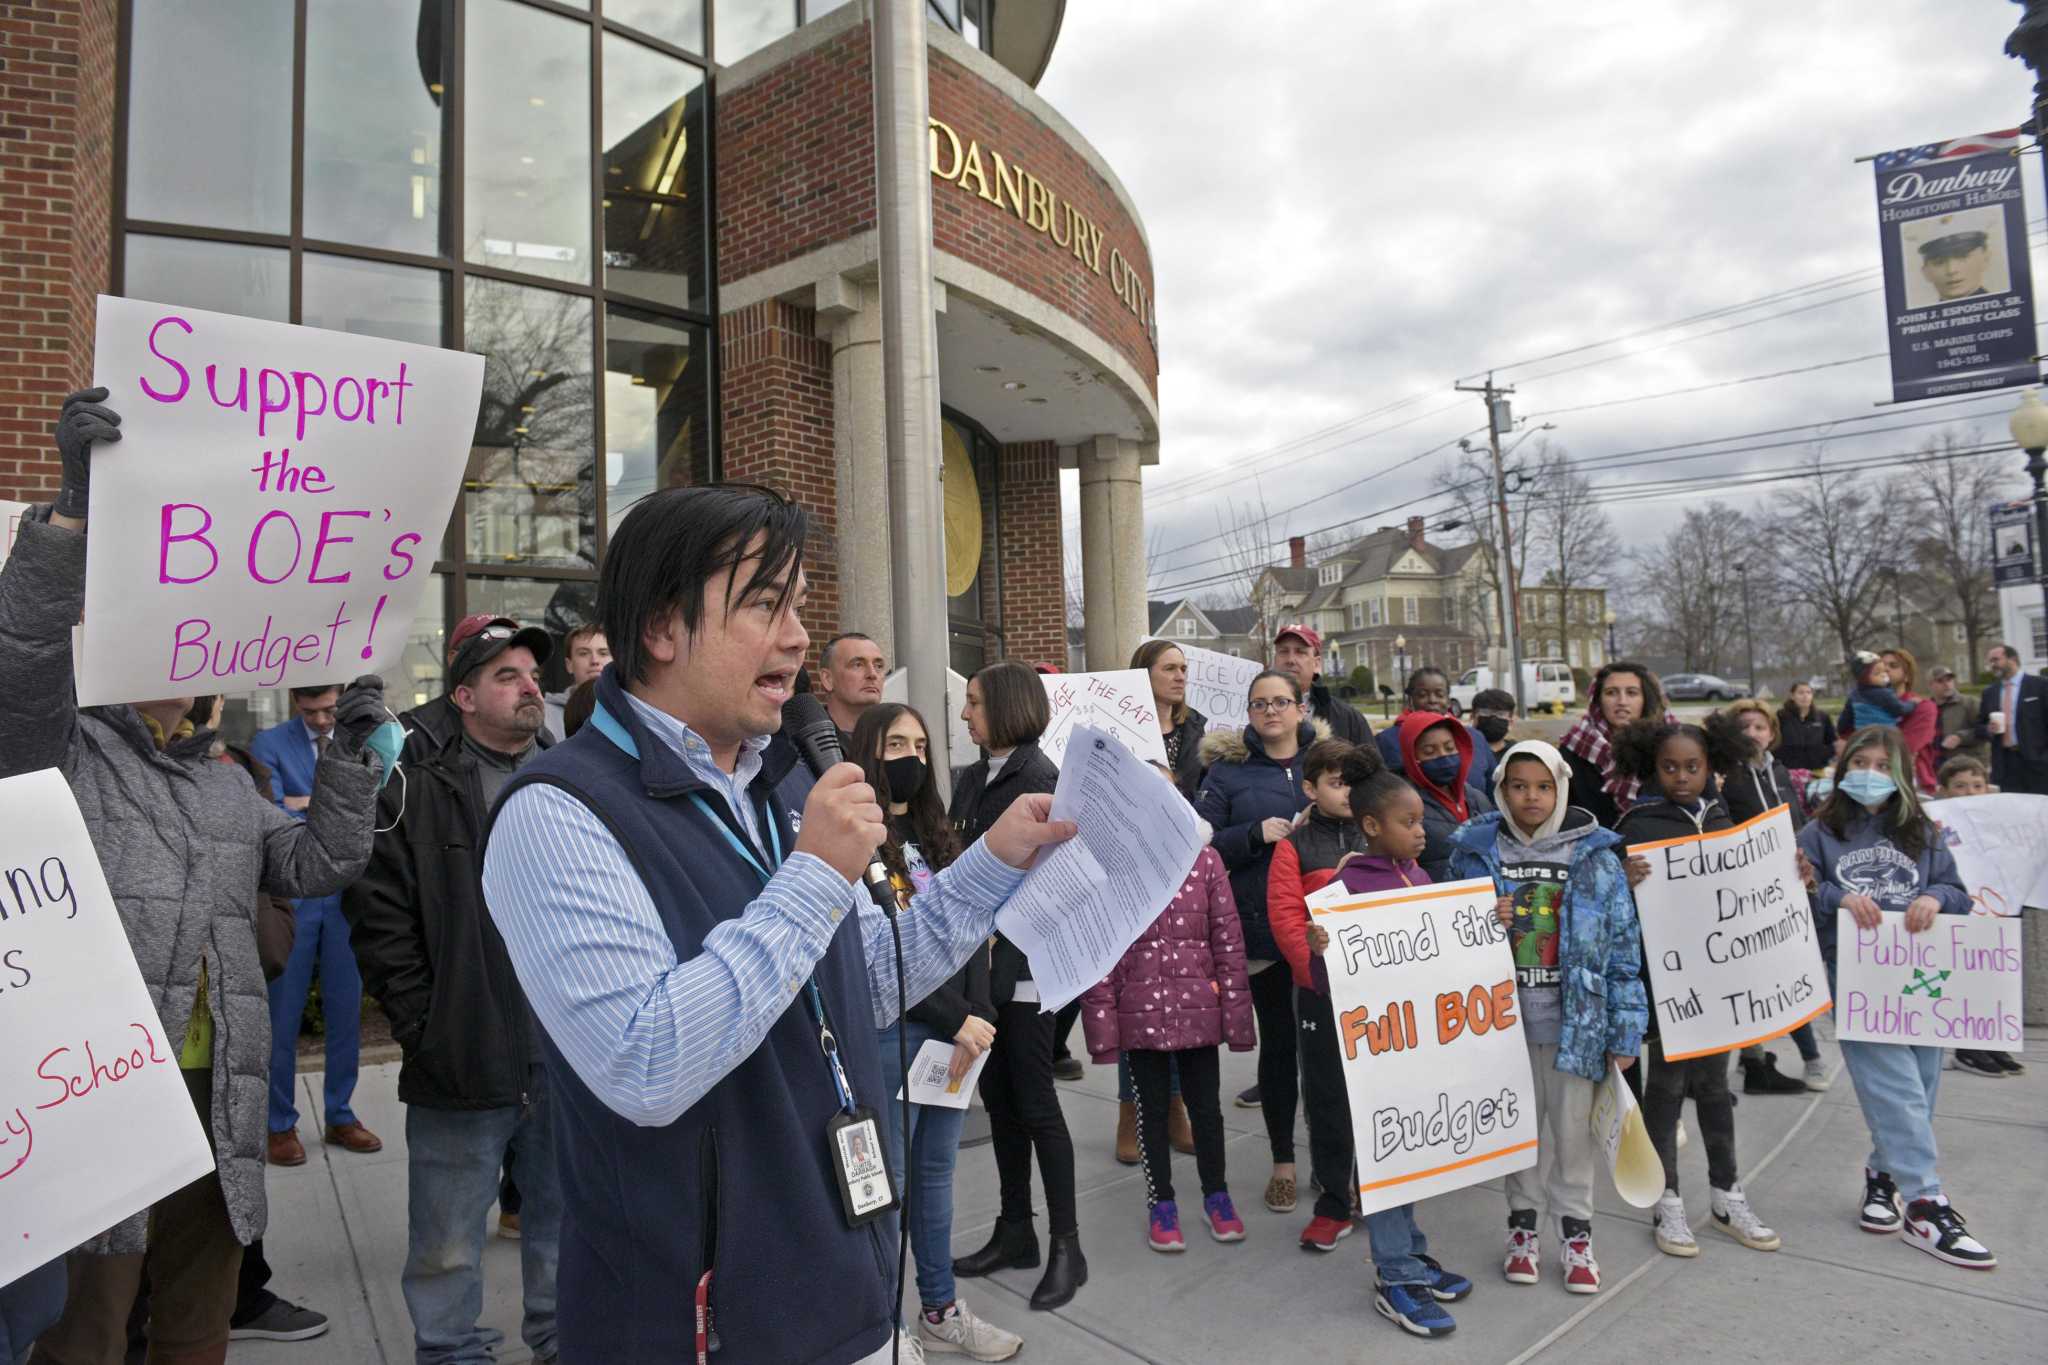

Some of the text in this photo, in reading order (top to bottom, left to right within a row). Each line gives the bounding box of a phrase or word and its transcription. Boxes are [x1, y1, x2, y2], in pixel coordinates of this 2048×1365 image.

[1881, 164, 2017, 205] Danbury
[928, 117, 1148, 326] DANBURY CITY
[1882, 199, 1961, 222] HOMETOWN
[1896, 312, 1927, 325] JOHN
[1902, 308, 2021, 335] PRIVATE FIRST CLASS
[1934, 334, 1976, 348] MARINE
[1977, 328, 2014, 341] CORPS
[140, 316, 414, 441] Support
[251, 448, 335, 494] the
[159, 503, 423, 585] BOE's
[1087, 676, 1118, 701] THE
[1118, 695, 1154, 725] GAP
[1501, 866, 1552, 879] asters
[1664, 826, 1781, 881] Education
[1716, 877, 1785, 923] Drives
[1338, 905, 1506, 975] Fund the
[1663, 903, 1811, 972] a Community
[1856, 924, 2021, 973] Public Funds
[1340, 979, 1517, 1060] Full BOE
[1657, 974, 1814, 1026] That Thrives
[1847, 991, 2022, 1042] Public Schools
[36, 1023, 166, 1109] School
[1373, 1088, 1520, 1162] Budget
